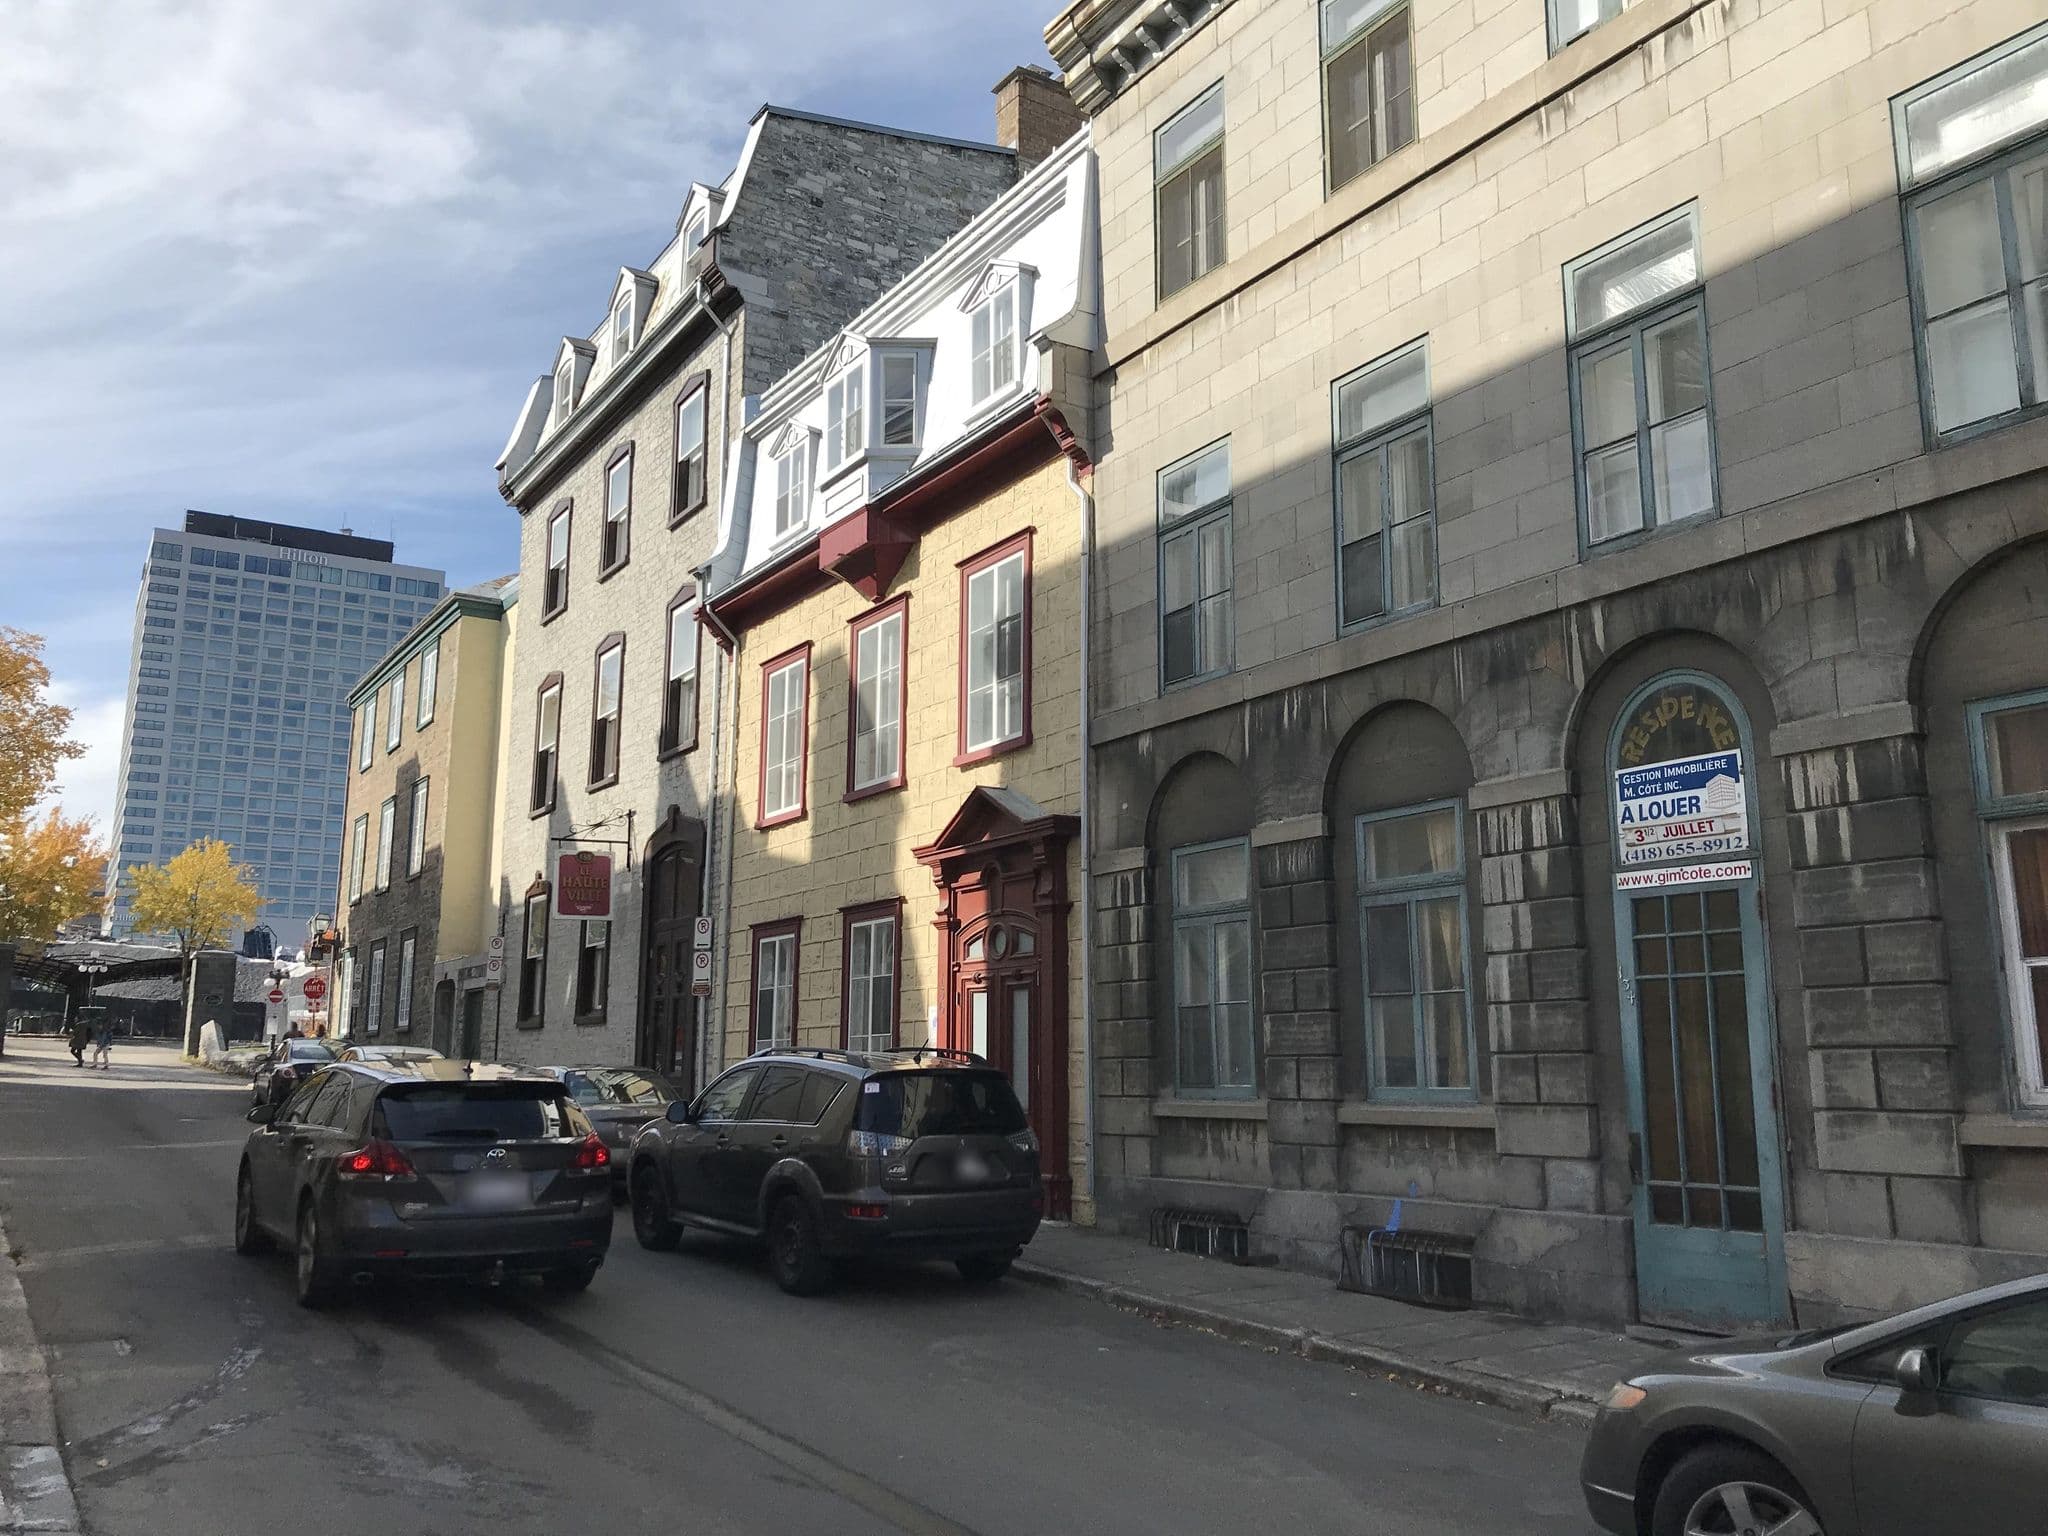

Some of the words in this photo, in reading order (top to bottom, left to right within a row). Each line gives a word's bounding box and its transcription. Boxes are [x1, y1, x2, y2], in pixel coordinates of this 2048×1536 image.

[279, 546, 328, 566] Hilton
[1621, 696, 1735, 762] RESIDENCE
[1623, 770, 1661, 785] GESTION
[1624, 788, 1636, 799] M.
[1664, 780, 1682, 791] INC.
[1639, 796, 1701, 821] LOUER
[1663, 820, 1715, 838] JUILLET
[1625, 846, 1662, 862] (418)
[1666, 837, 1742, 856] 655-8912
[562, 876, 608, 888] HAUTE
[1620, 865, 1747, 887] www.gimcote.com
[304, 984, 325, 992] ARRÊT
